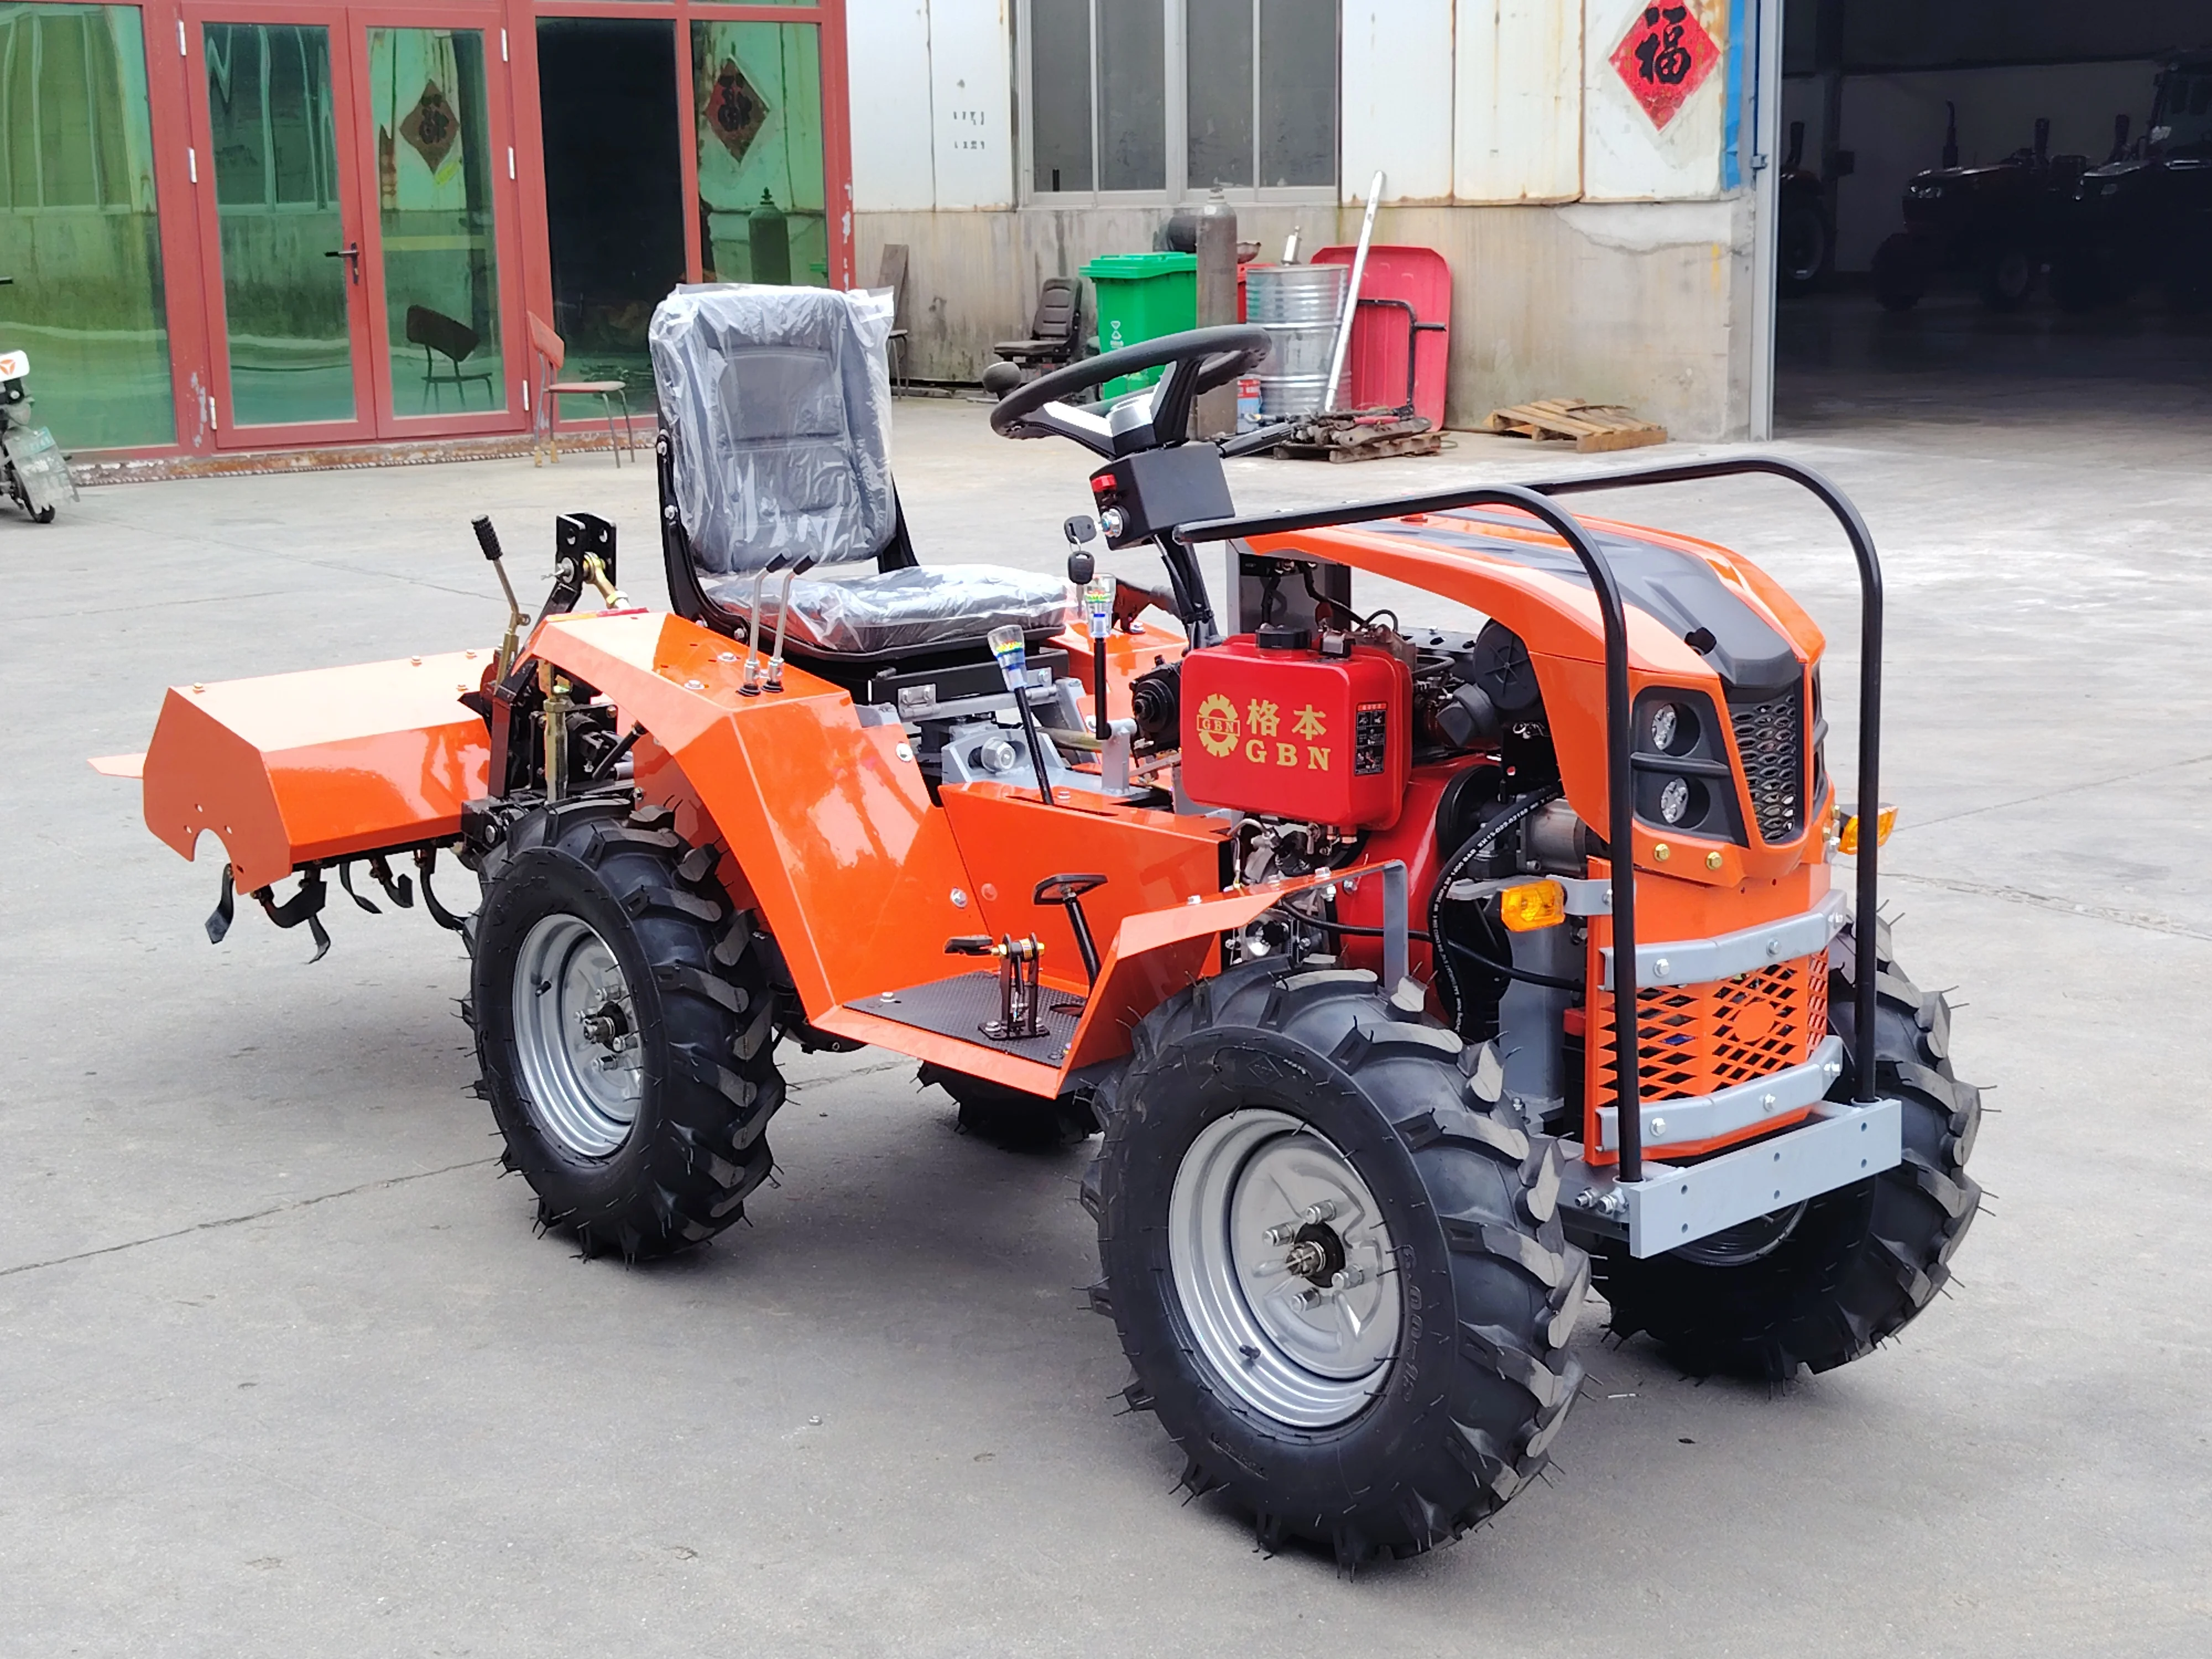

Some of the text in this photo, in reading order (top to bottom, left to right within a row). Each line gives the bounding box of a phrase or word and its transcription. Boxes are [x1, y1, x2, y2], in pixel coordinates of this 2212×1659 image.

[1635, 6, 1692, 85] 福
[1202, 719, 1234, 733] GBN
[1246, 698, 1327, 740] 格本
[1245, 739, 1331, 771] GBN
